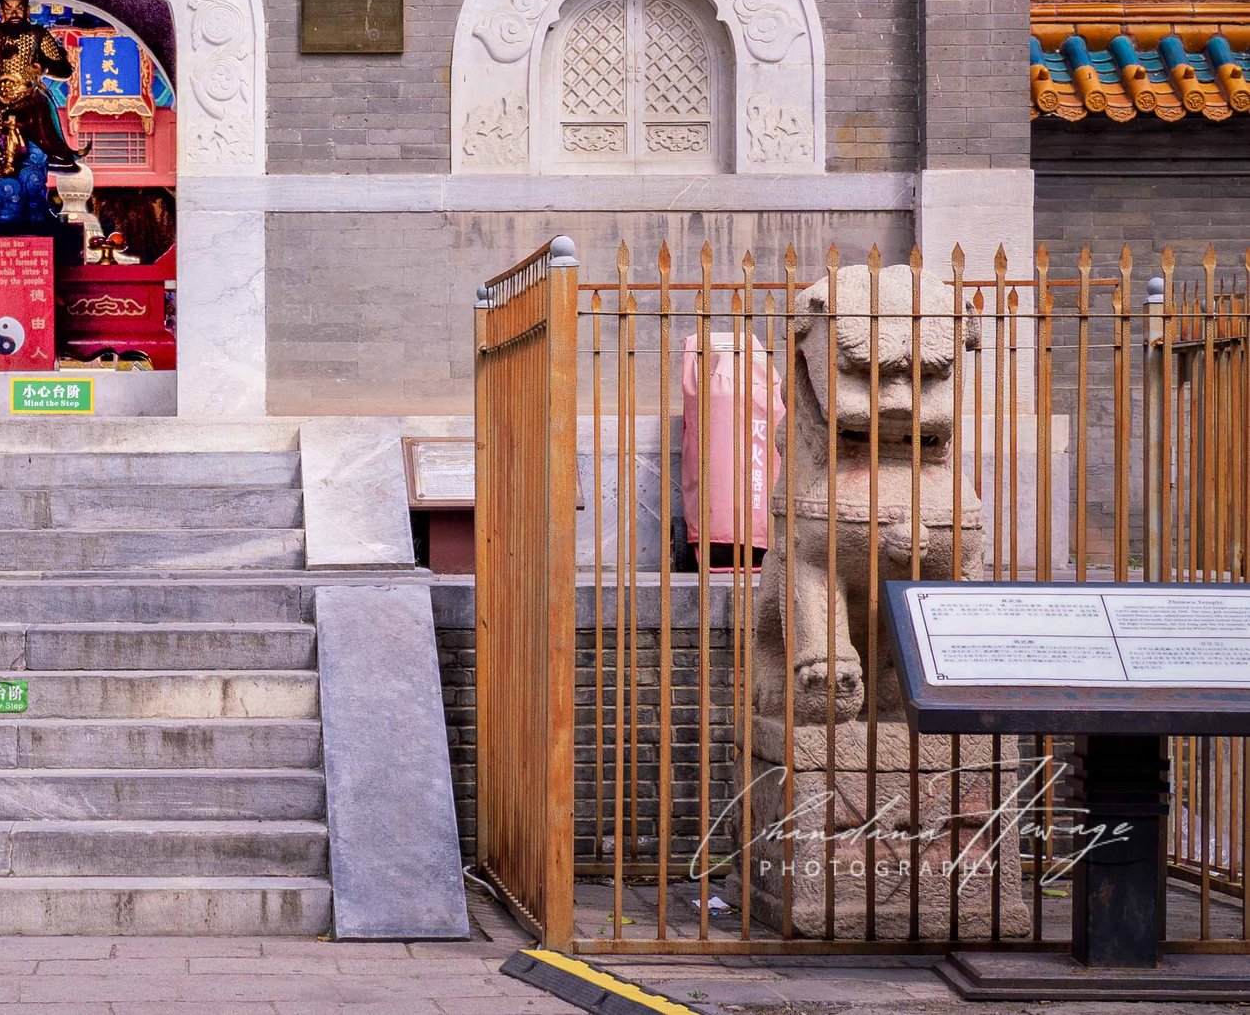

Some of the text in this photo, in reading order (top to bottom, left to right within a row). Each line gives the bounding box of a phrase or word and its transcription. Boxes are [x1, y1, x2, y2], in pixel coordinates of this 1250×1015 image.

[13, 240, 25, 248] box
[6, 249, 17, 257] will
[19, 250, 30, 258] get
[40, 258, 49, 267] by
[22, 268, 40, 276] virtue
[0, 277, 8, 287] by
[10, 277, 21, 286] the
[22, 384, 81, 399] 小心台阶
[23, 399, 80, 408] Mind the Step
[5, 702, 24, 710] Step
